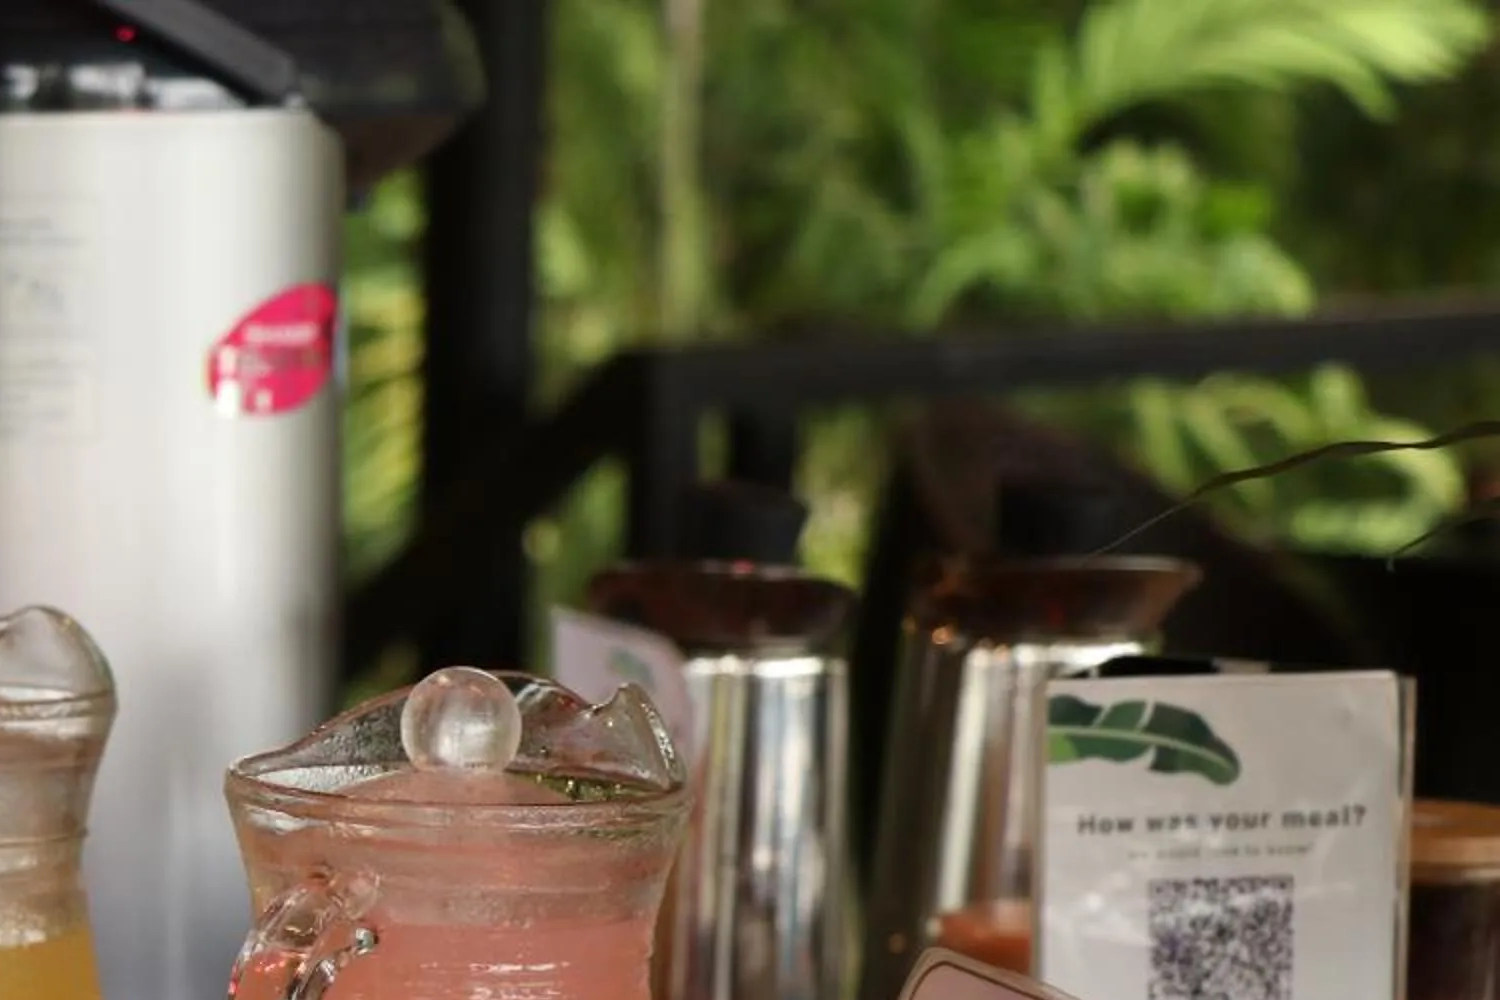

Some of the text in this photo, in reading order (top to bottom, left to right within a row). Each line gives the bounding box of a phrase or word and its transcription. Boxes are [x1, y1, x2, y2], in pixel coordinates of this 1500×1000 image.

[1077, 804, 1366, 835] How was your meal?
